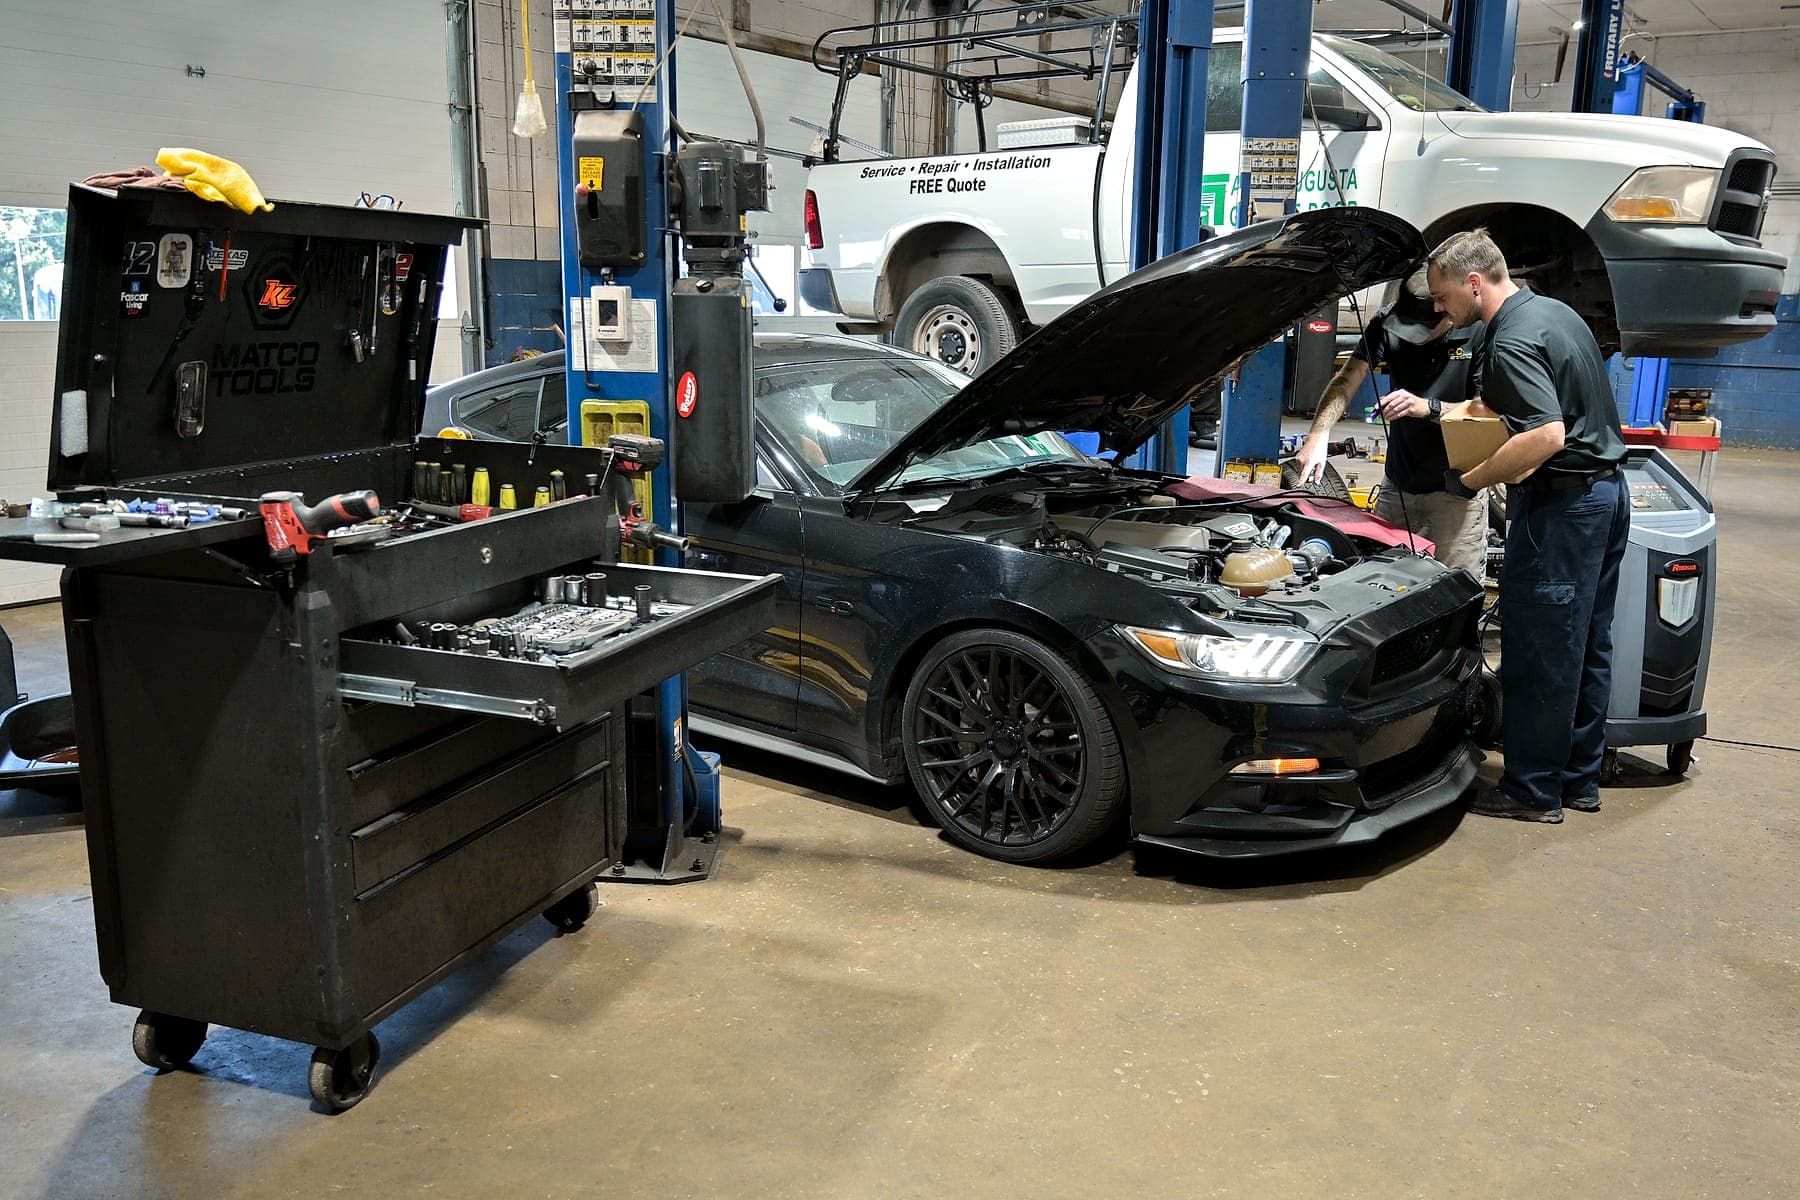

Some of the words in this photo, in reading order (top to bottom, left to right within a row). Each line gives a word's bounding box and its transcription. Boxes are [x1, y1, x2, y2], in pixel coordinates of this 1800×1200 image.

[1604, 14, 1619, 71] ROTARY
[860, 165, 906, 179] Service
[917, 160, 961, 176] Repair
[972, 155, 1052, 171] Installation
[909, 179, 943, 194] FREE
[946, 177, 986, 193] Quote
[1296, 168, 1358, 193] UGUSTA
[212, 341, 320, 368] MATCO
[210, 366, 316, 397] TOOLS
